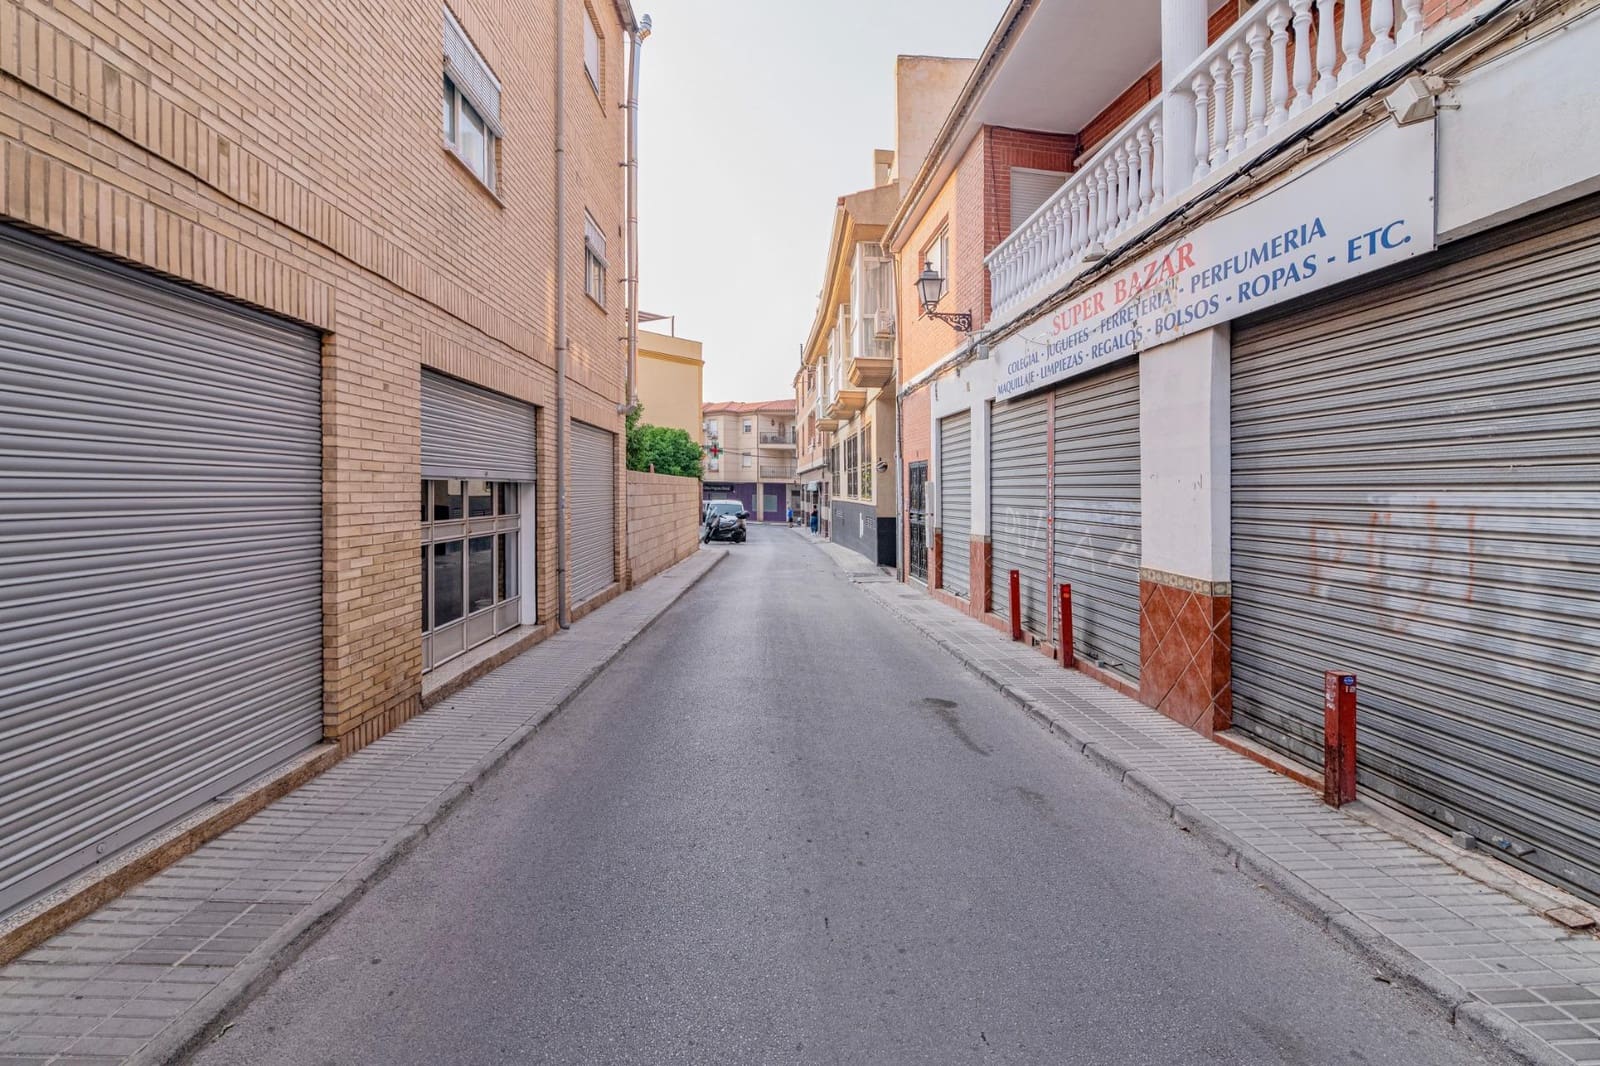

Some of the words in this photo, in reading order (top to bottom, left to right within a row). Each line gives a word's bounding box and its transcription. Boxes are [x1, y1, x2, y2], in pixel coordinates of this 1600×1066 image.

[997, 370, 1035, 394] MAQUILLAJE
[1040, 350, 1083, 380] LIMPIEZAS
[1091, 325, 1143, 360] REGALOS
[1154, 294, 1219, 335] BOLSOS
[1238, 254, 1318, 304] ROPAS
[1347, 219, 1412, 264] ETC.
[1007, 351, 1040, 376] COLEGIAL
[1046, 327, 1089, 360] JUGUETES
[1100, 288, 1172, 334] FERRETERIA
[1191, 217, 1327, 294] PERFUMERIA
[1053, 291, 1105, 336] SUPER
[1113, 242, 1196, 305] BAZAR
